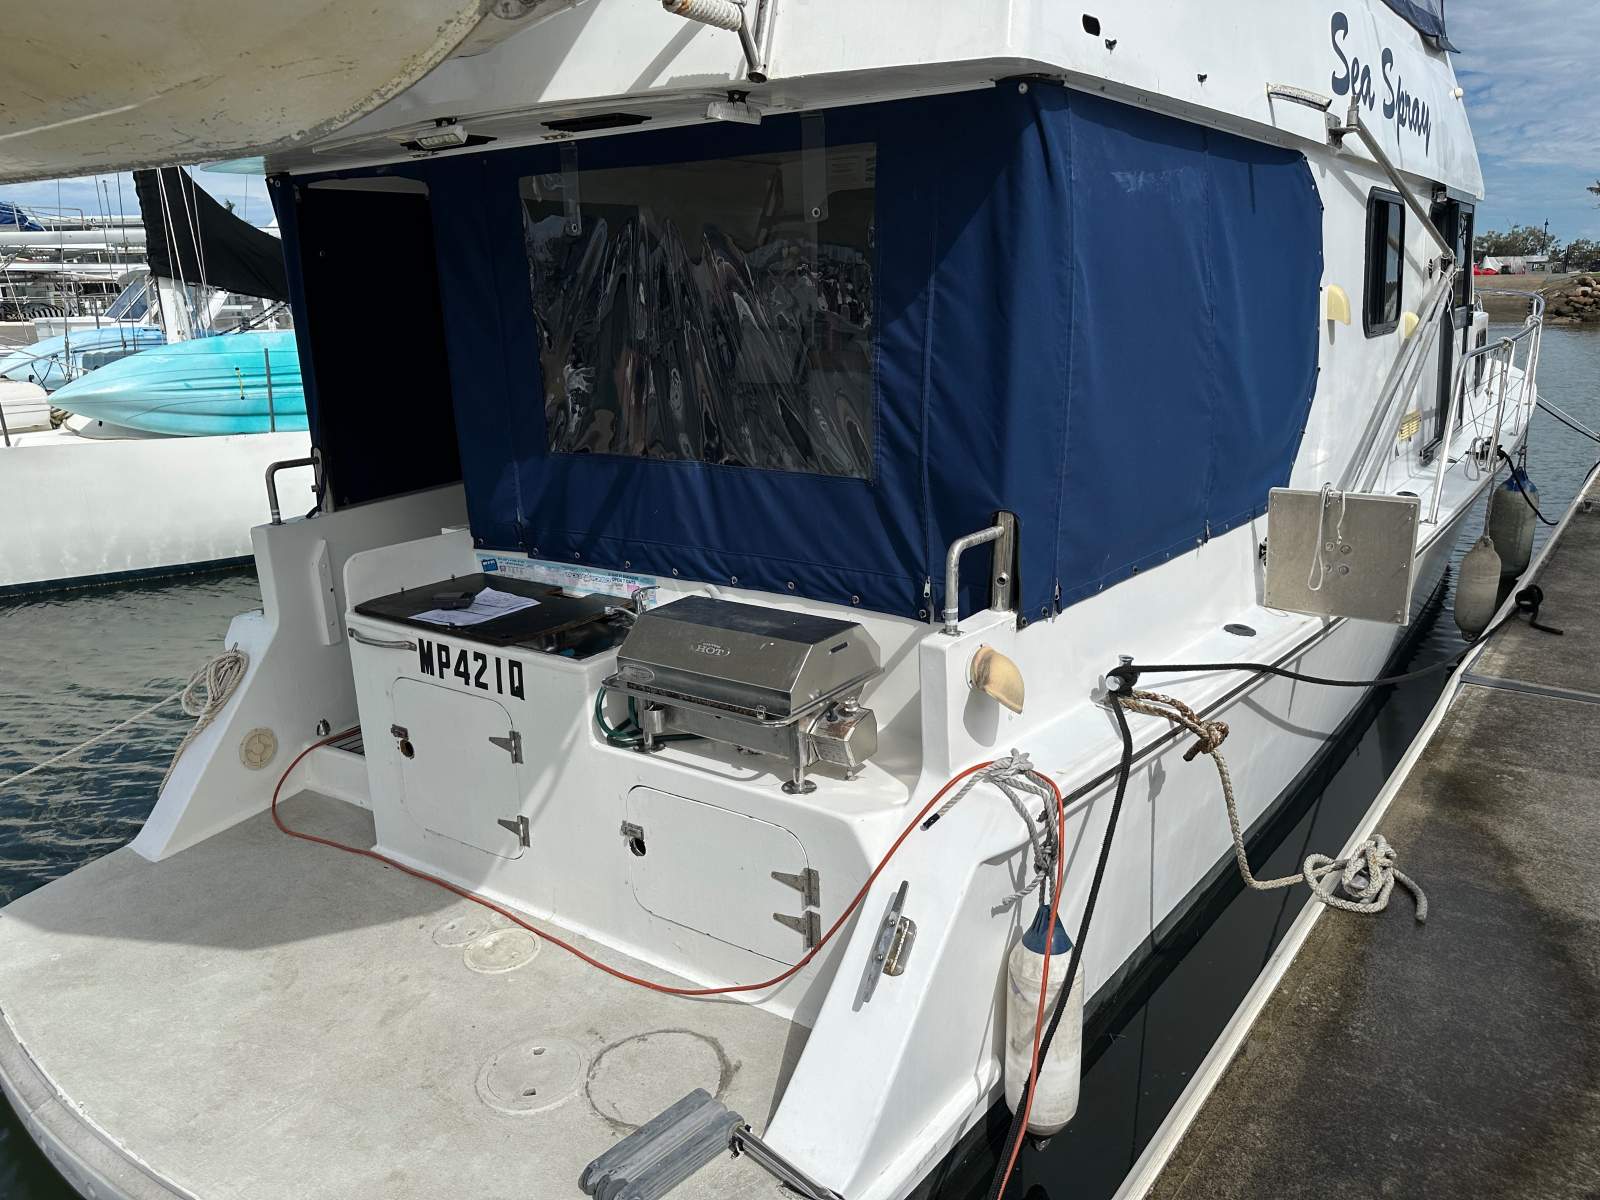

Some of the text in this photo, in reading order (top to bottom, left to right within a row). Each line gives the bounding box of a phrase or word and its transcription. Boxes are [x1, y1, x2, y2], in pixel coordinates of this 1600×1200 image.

[1331, 11, 1431, 157] Sea Spray
[418, 638, 525, 701] MP421Q
